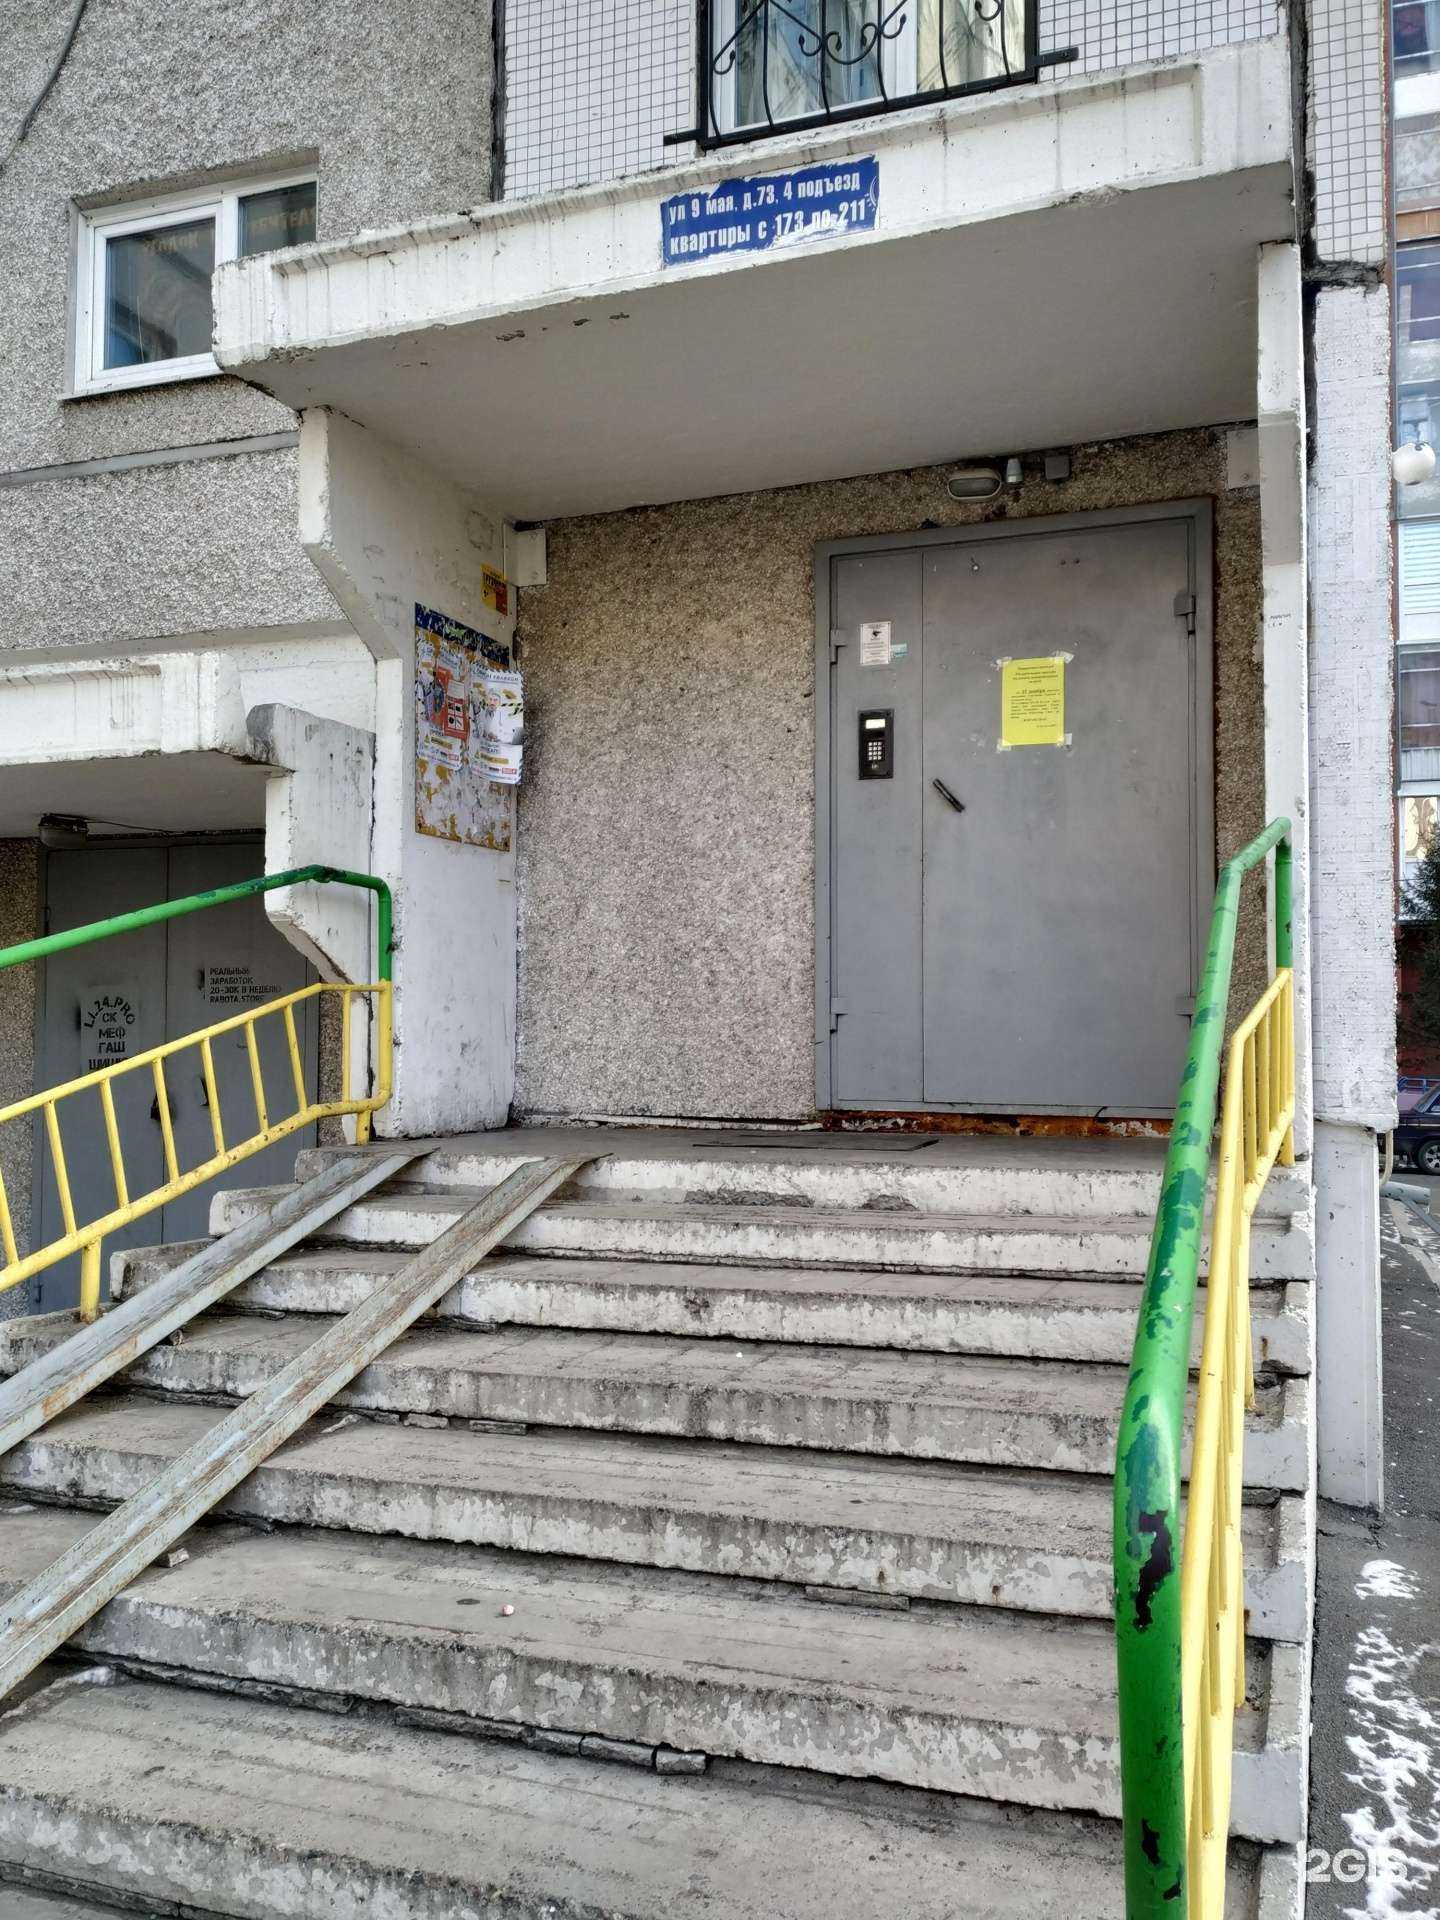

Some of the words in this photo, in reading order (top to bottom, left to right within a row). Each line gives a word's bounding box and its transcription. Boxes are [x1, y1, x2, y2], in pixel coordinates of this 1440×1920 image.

[669, 205, 686, 225] ул
[691, 201, 701, 218] 9
[783, 181, 793, 201] 4
[797, 172, 861, 198] подъезд
[670, 221, 751, 255] квартиры
[758, 221, 768, 240] с
[775, 211, 804, 236] 173
[839, 201, 866, 226] 211
[209, 976, 255, 985] ЗАРАБОТОК
[249, 984, 282, 994] НЕДЕЛЮ
[102, 1012, 118, 1023] СК
[98, 1026, 126, 1039] МЕФ
[98, 1041, 126, 1054] ГАШ
